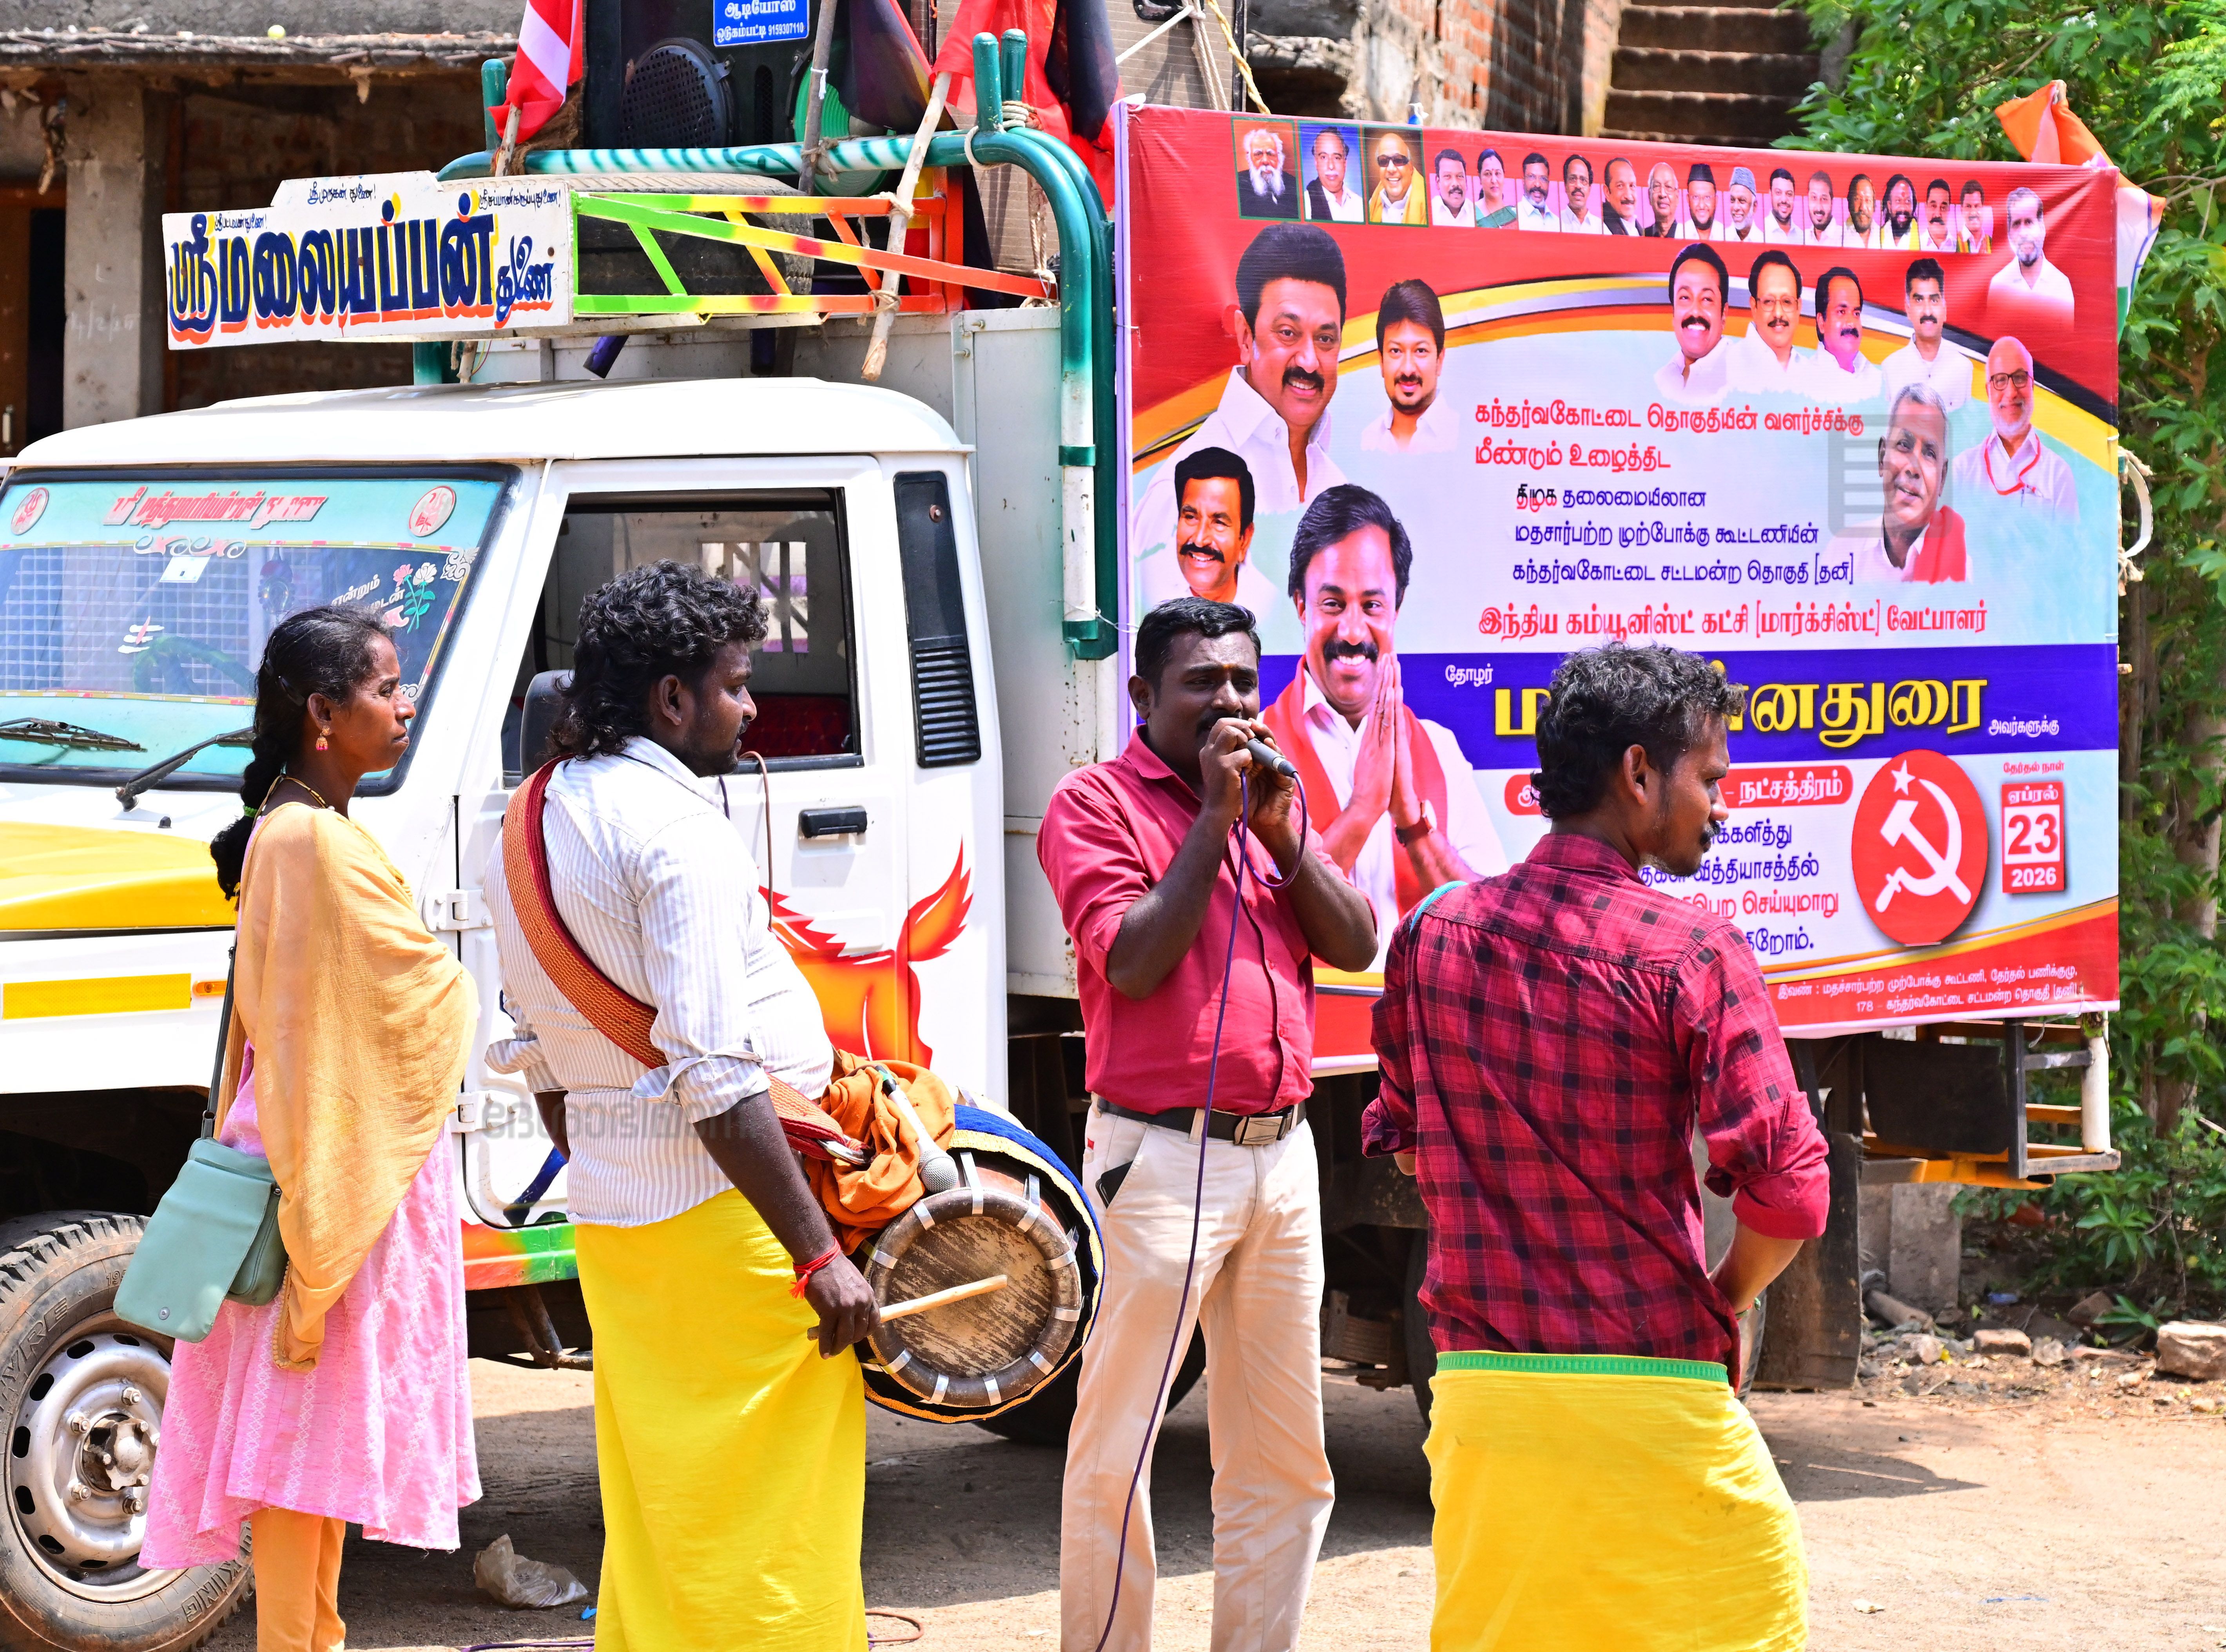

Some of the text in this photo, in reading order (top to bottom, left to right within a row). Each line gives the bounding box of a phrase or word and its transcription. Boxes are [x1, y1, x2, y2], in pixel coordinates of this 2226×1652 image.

[725, 0, 796, 19] ஆடியோஸ
[768, 22, 804, 36] 9159307110
[1476, 397, 1864, 436] கந்தர்வகோட்டை தொகுதியின் வளர்ச்சிக்கு
[1476, 436, 1671, 472] மீண்டும் உழைத்திட
[1517, 484, 1706, 512] திமுக தலைமையிலான
[1515, 520, 1819, 548] மதசார்பற்ற முற்போக்கு கூட்டணியின்
[1513, 558, 1655, 584] கந்தர்வகோட்டை
[1661, 559, 1742, 584] சட்டமன்ற
[1748, 560, 1809, 584] தொகுதி
[1479, 603, 1558, 643] இந்திய
[1567, 603, 1695, 643] கம்யூனிஸ்ட்
[1702, 604, 1748, 634] கட்சி
[1887, 599, 1988, 633] வேட்பாளர்
[1445, 663, 1494, 688] தோழர்
[1989, 715, 2059, 737] அவர்களுக்கு
[2003, 760, 2065, 776] தேர்தல் நாள்
[1739, 769, 1843, 806] நட்சத்திரம்
[2008, 784, 2059, 804] ஏப்ரல்
[2008, 813, 2059, 855] 23
[2012, 867, 2057, 888] 2026
[1743, 889, 1839, 918] செய்யுமாறு
[1778, 981, 1813, 1000] இவண்
[1991, 965, 2025, 985] தேர்தல்
[1856, 1001, 1874, 1013] 178
[1968, 988, 2012, 1005] சட்டமன்ற
[2015, 984, 2050, 1004] தொகுதி
